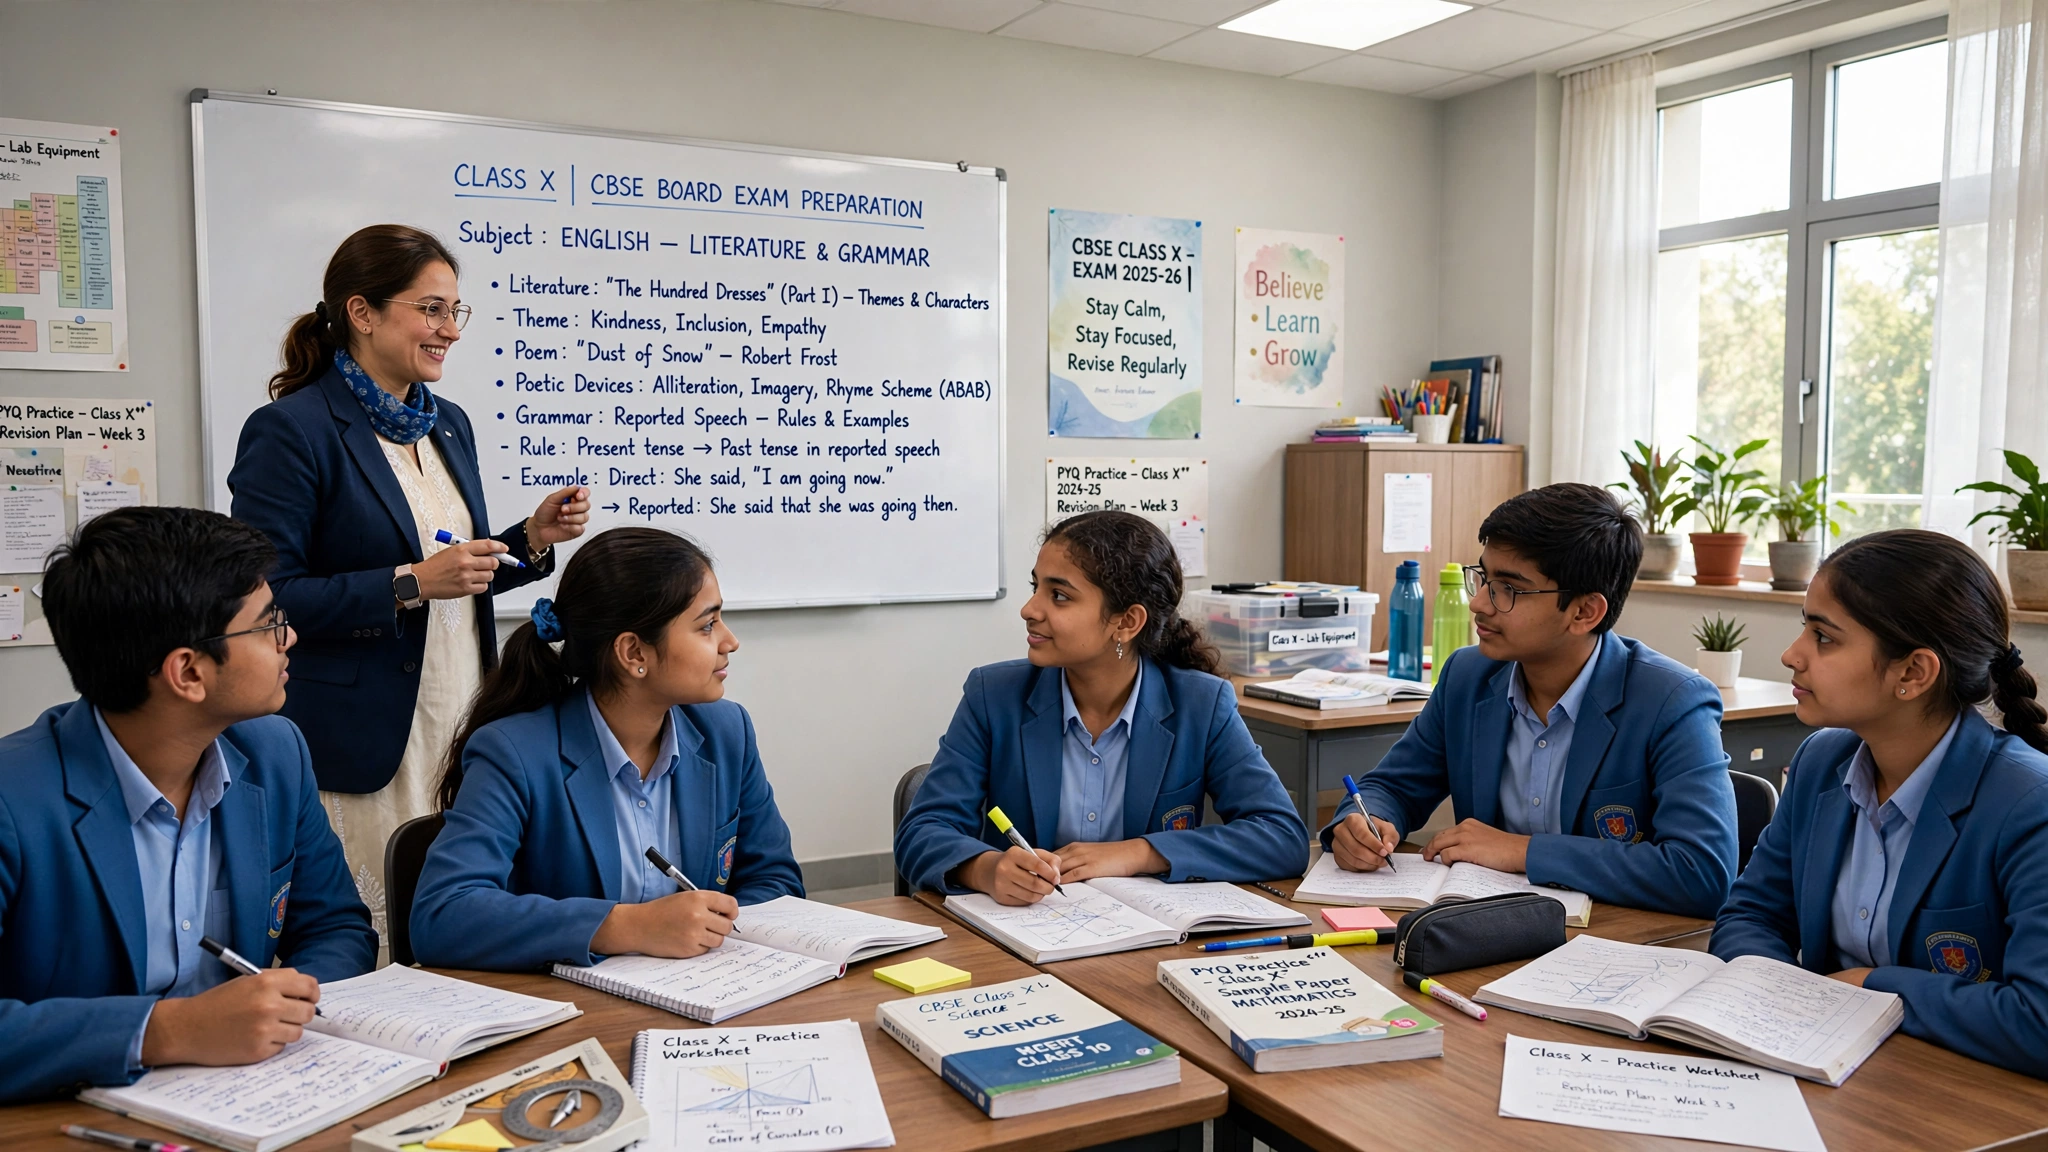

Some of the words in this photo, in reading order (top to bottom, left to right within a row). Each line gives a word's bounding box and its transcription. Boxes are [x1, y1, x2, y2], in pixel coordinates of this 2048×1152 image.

[10, 140, 32, 153] Lab
[37, 143, 100, 159] Equipment
[454, 164, 526, 189] CLASS
[541, 170, 555, 191] X
[591, 174, 643, 197] CBSE
[658, 179, 722, 202] BOARD
[736, 185, 788, 208] EXAM
[802, 190, 922, 219] PREPARATION
[562, 227, 649, 251] ENGLISH
[690, 234, 806, 260] LITERATURE
[817, 243, 828, 261] &
[838, 243, 930, 267] GRAMMAR
[1072, 237, 1113, 256] CBSE
[1118, 241, 1166, 261] CLASS
[1171, 245, 1181, 262] X
[1073, 261, 1117, 280] EXAM
[1123, 265, 1182, 284] 2025-26
[650, 279, 708, 299] Hundred
[781, 283, 815, 305] (Part
[822, 285, 838, 308] I)
[858, 289, 904, 307] Themes
[911, 292, 920, 307] &
[925, 291, 989, 310] Characters
[1256, 270, 1323, 300] Believe
[1086, 297, 1119, 320] Stay
[1124, 299, 1165, 321] Calm,
[1266, 305, 1319, 334] Learn
[592, 309, 666, 334] Kindness,
[676, 313, 752, 336] Inclusion,
[762, 315, 826, 343] Empathy
[1076, 325, 1109, 348] Stay
[1115, 327, 1176, 350] Focused,
[635, 343, 653, 368] of
[742, 345, 791, 365] Robert
[801, 348, 837, 366] Frost
[1265, 340, 1317, 367] Grow
[1068, 353, 1114, 372] Revise
[1121, 355, 1186, 380] Regularly
[516, 372, 564, 392] Poetic
[653, 375, 743, 398] Alliteration,
[751, 377, 818, 404] Imagery,
[827, 378, 873, 404] Rhyme
[881, 380, 932, 398] Scheme
[939, 379, 991, 402] (ABAB)
[27, 406, 74, 419] Practice
[91, 407, 121, 420] Class
[615, 406, 684, 432] Reported
[694, 407, 747, 433] Speech
[778, 408, 816, 426] Rules
[824, 410, 835, 427] &
[844, 409, 909, 434] Examples
[0, 425, 50, 439] Revision
[56, 426, 82, 439] Plan
[99, 427, 133, 440] Week
[137, 428, 145, 441] 3
[578, 436, 635, 456] Present
[644, 437, 684, 456] tense
[721, 438, 752, 456] Past
[760, 438, 798, 456] tense
[807, 441, 820, 456] in
[828, 439, 887, 462] reported
[895, 439, 940, 463] speech
[674, 467, 702, 485] She
[710, 467, 745, 488] said,
[780, 474, 801, 485] am
[809, 471, 846, 494] going
[1058, 466, 1080, 481] PYQ
[1085, 466, 1127, 479] Practice
[1142, 467, 1168, 480] Class
[710, 497, 736, 514] She
[744, 496, 773, 514] said
[781, 496, 811, 513] that
[819, 496, 841, 513] she
[849, 502, 874, 512] was
[882, 498, 916, 521] going
[923, 495, 957, 511] then.
[1058, 500, 1099, 512] Revision
[1105, 500, 1125, 511] Plan
[1140, 499, 1167, 511] Week
[1171, 500, 1178, 511] 3
[1292, 635, 1297, 643] X
[1191, 966, 1233, 976] PYQ
[1295, 977, 1350, 989] Paper
[919, 998, 965, 1013] CBSE
[974, 991, 1014, 1003] Class
[948, 1005, 1008, 1021] Science
[1275, 1005, 1345, 1019] 2024-25
[964, 1014, 1064, 1038] SCIENCE
[664, 1037, 709, 1046] Class
[718, 1035, 729, 1044] X
[756, 1032, 820, 1042] Practice
[1086, 1043, 1111, 1054] 10
[663, 1047, 750, 1059] Worksheet
[1530, 1048, 1571, 1061] Class
[1581, 1053, 1592, 1063] X
[1617, 1057, 1677, 1072] Practice
